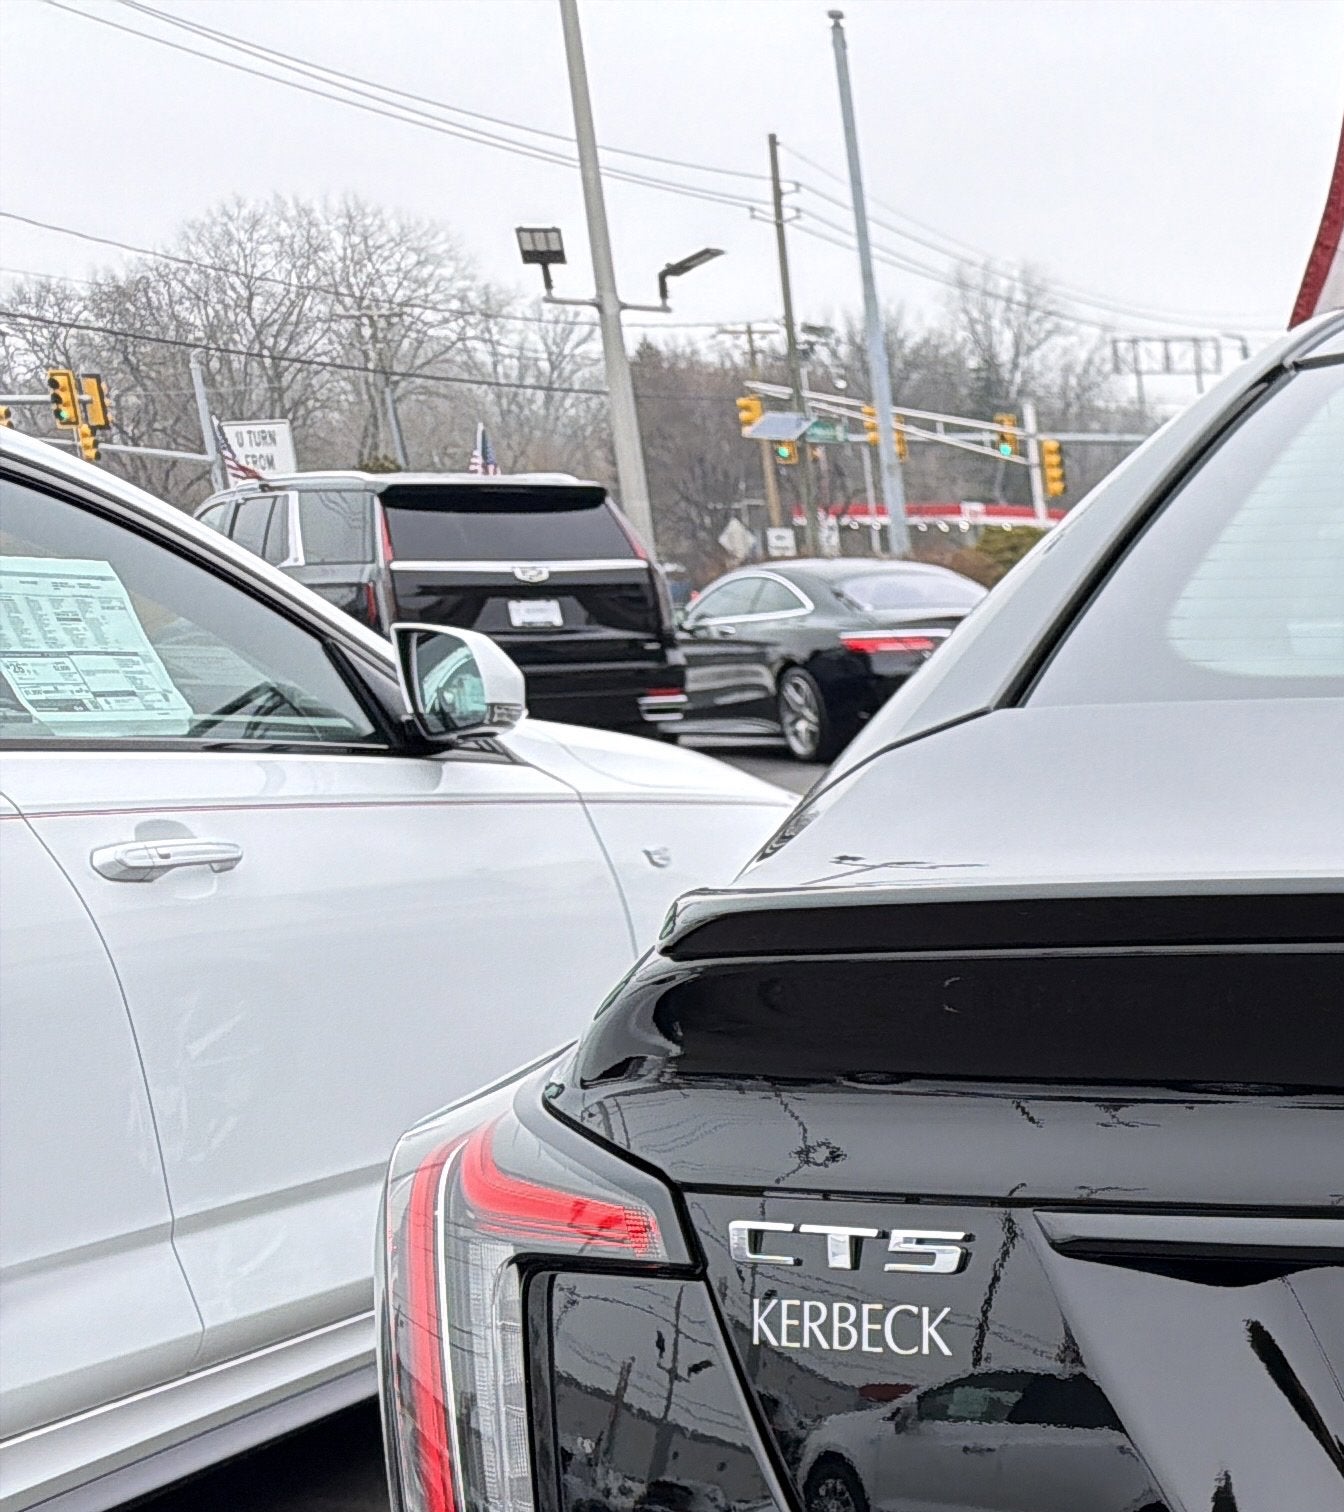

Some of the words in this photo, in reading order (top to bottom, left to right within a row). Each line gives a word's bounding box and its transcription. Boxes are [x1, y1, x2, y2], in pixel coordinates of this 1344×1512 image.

[235, 431, 245, 448] U
[246, 429, 276, 447] TURN
[752, 1298, 953, 1356] KERBECK
